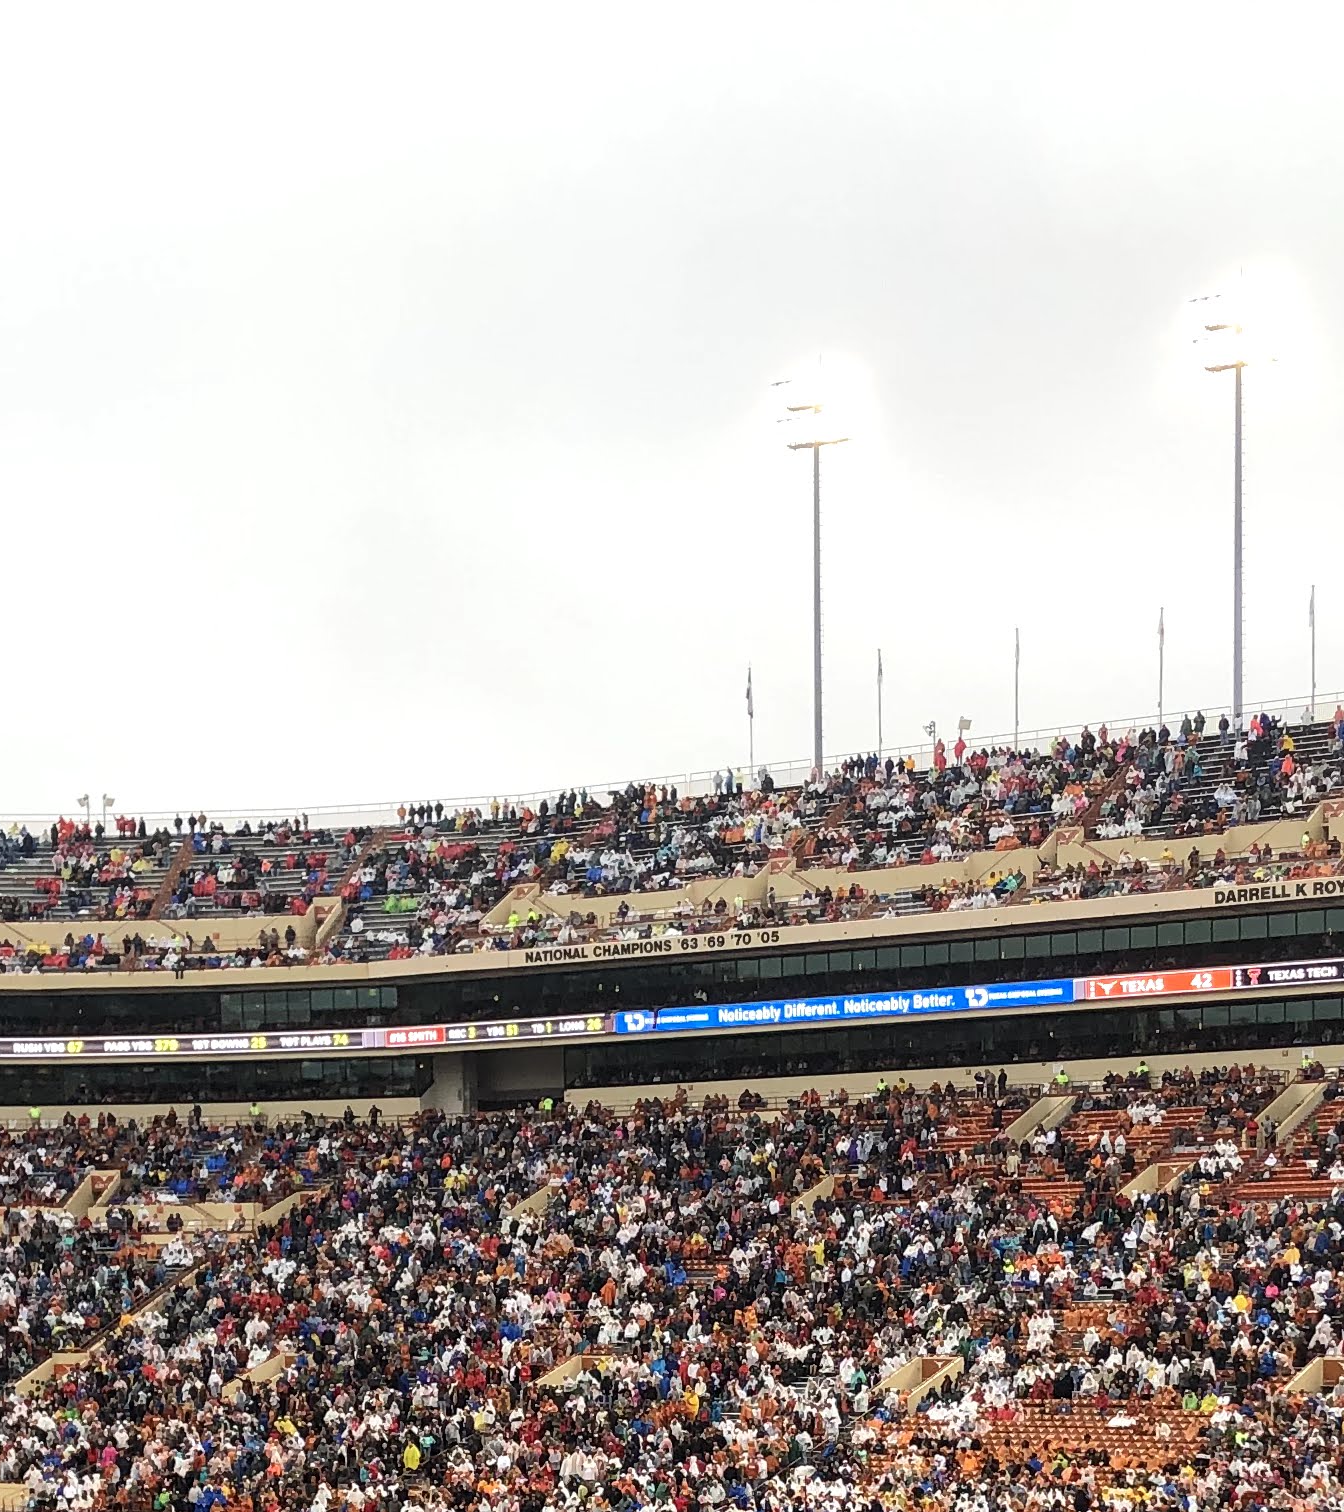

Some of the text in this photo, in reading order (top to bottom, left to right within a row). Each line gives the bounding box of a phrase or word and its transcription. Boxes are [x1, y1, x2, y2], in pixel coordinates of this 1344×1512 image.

[1214, 886, 1291, 904] DARRELL
[1295, 883, 1307, 897] K
[525, 947, 588, 963] NATIONAL
[593, 939, 671, 959] CHAMPIONS
[677, 937, 699, 951] '63
[730, 933, 752, 948] '70
[756, 930, 779, 945] '05
[1120, 973, 1213, 993] TEXAS 42
[1268, 967, 1304, 981] TEXAS
[1306, 965, 1337, 978] TECH
[719, 994, 956, 1023] Noticeably Different. Noticeably Better.
